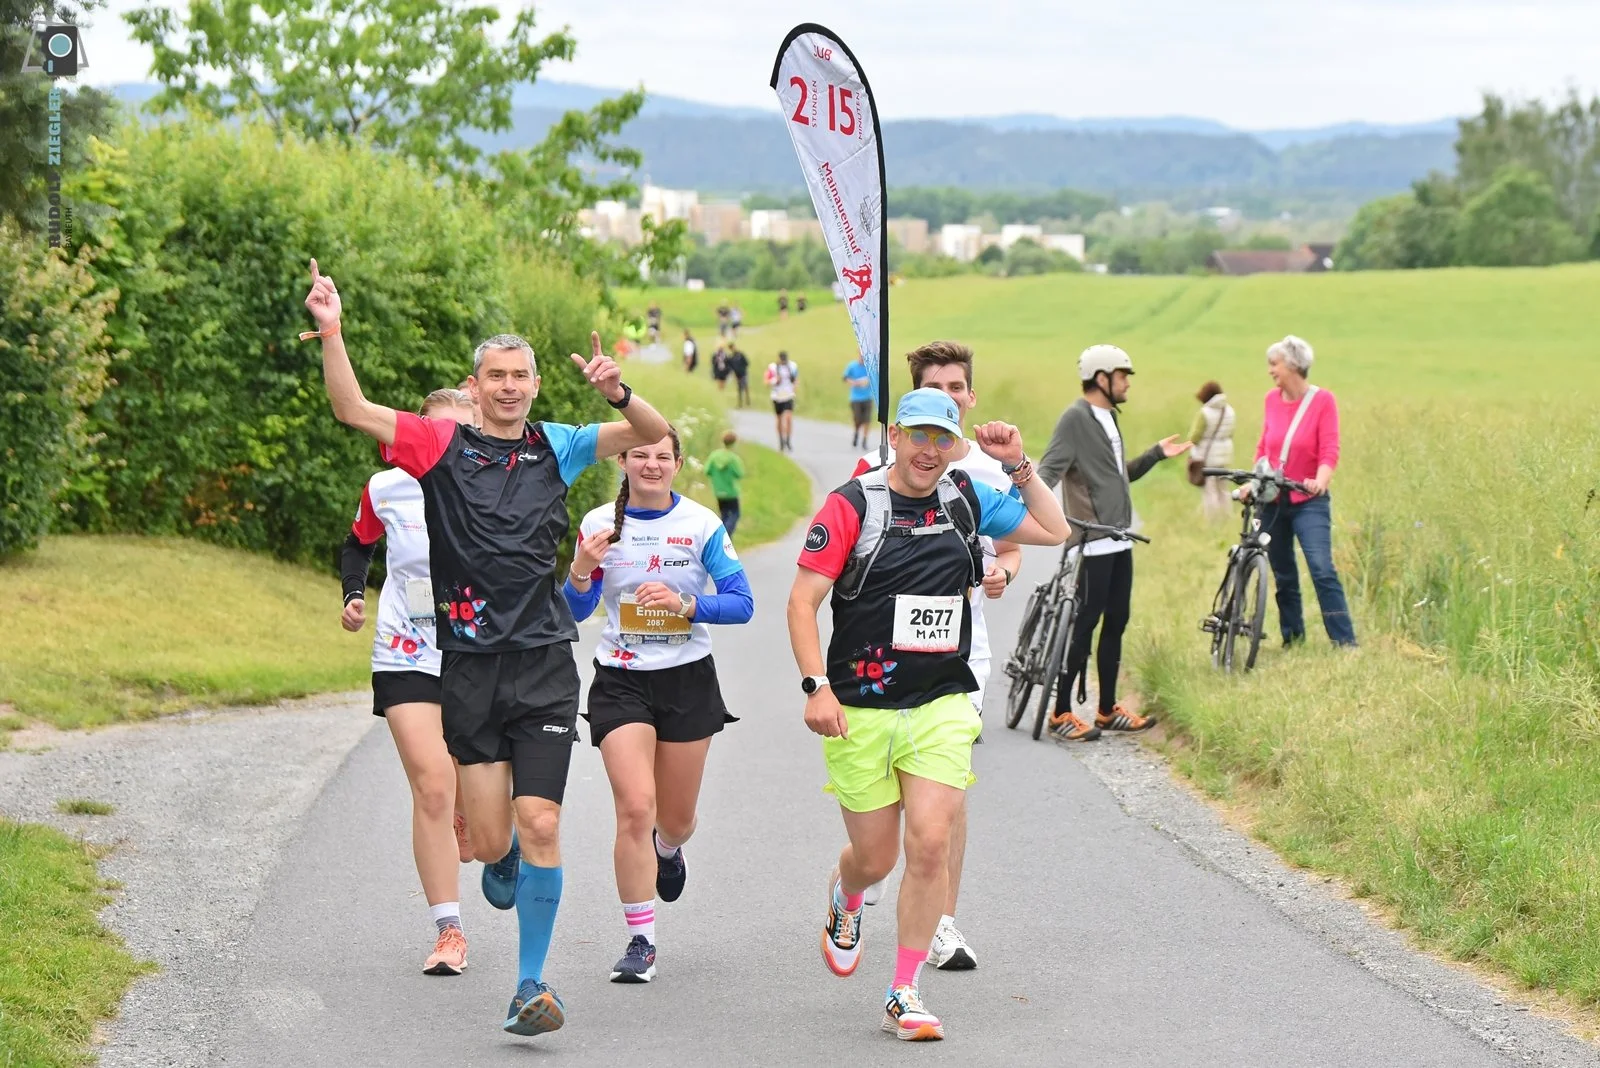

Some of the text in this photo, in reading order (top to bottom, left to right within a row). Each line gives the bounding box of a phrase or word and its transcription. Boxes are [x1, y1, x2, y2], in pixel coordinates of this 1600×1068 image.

[790, 76, 810, 126] 2
[828, 84, 856, 136] 15
[821, 161, 862, 255] Mainauenlauf
[667, 536, 693, 546] NKD
[646, 619, 666, 627] 2087
[910, 608, 953, 627] 2677
[916, 628, 951, 640] MATT
